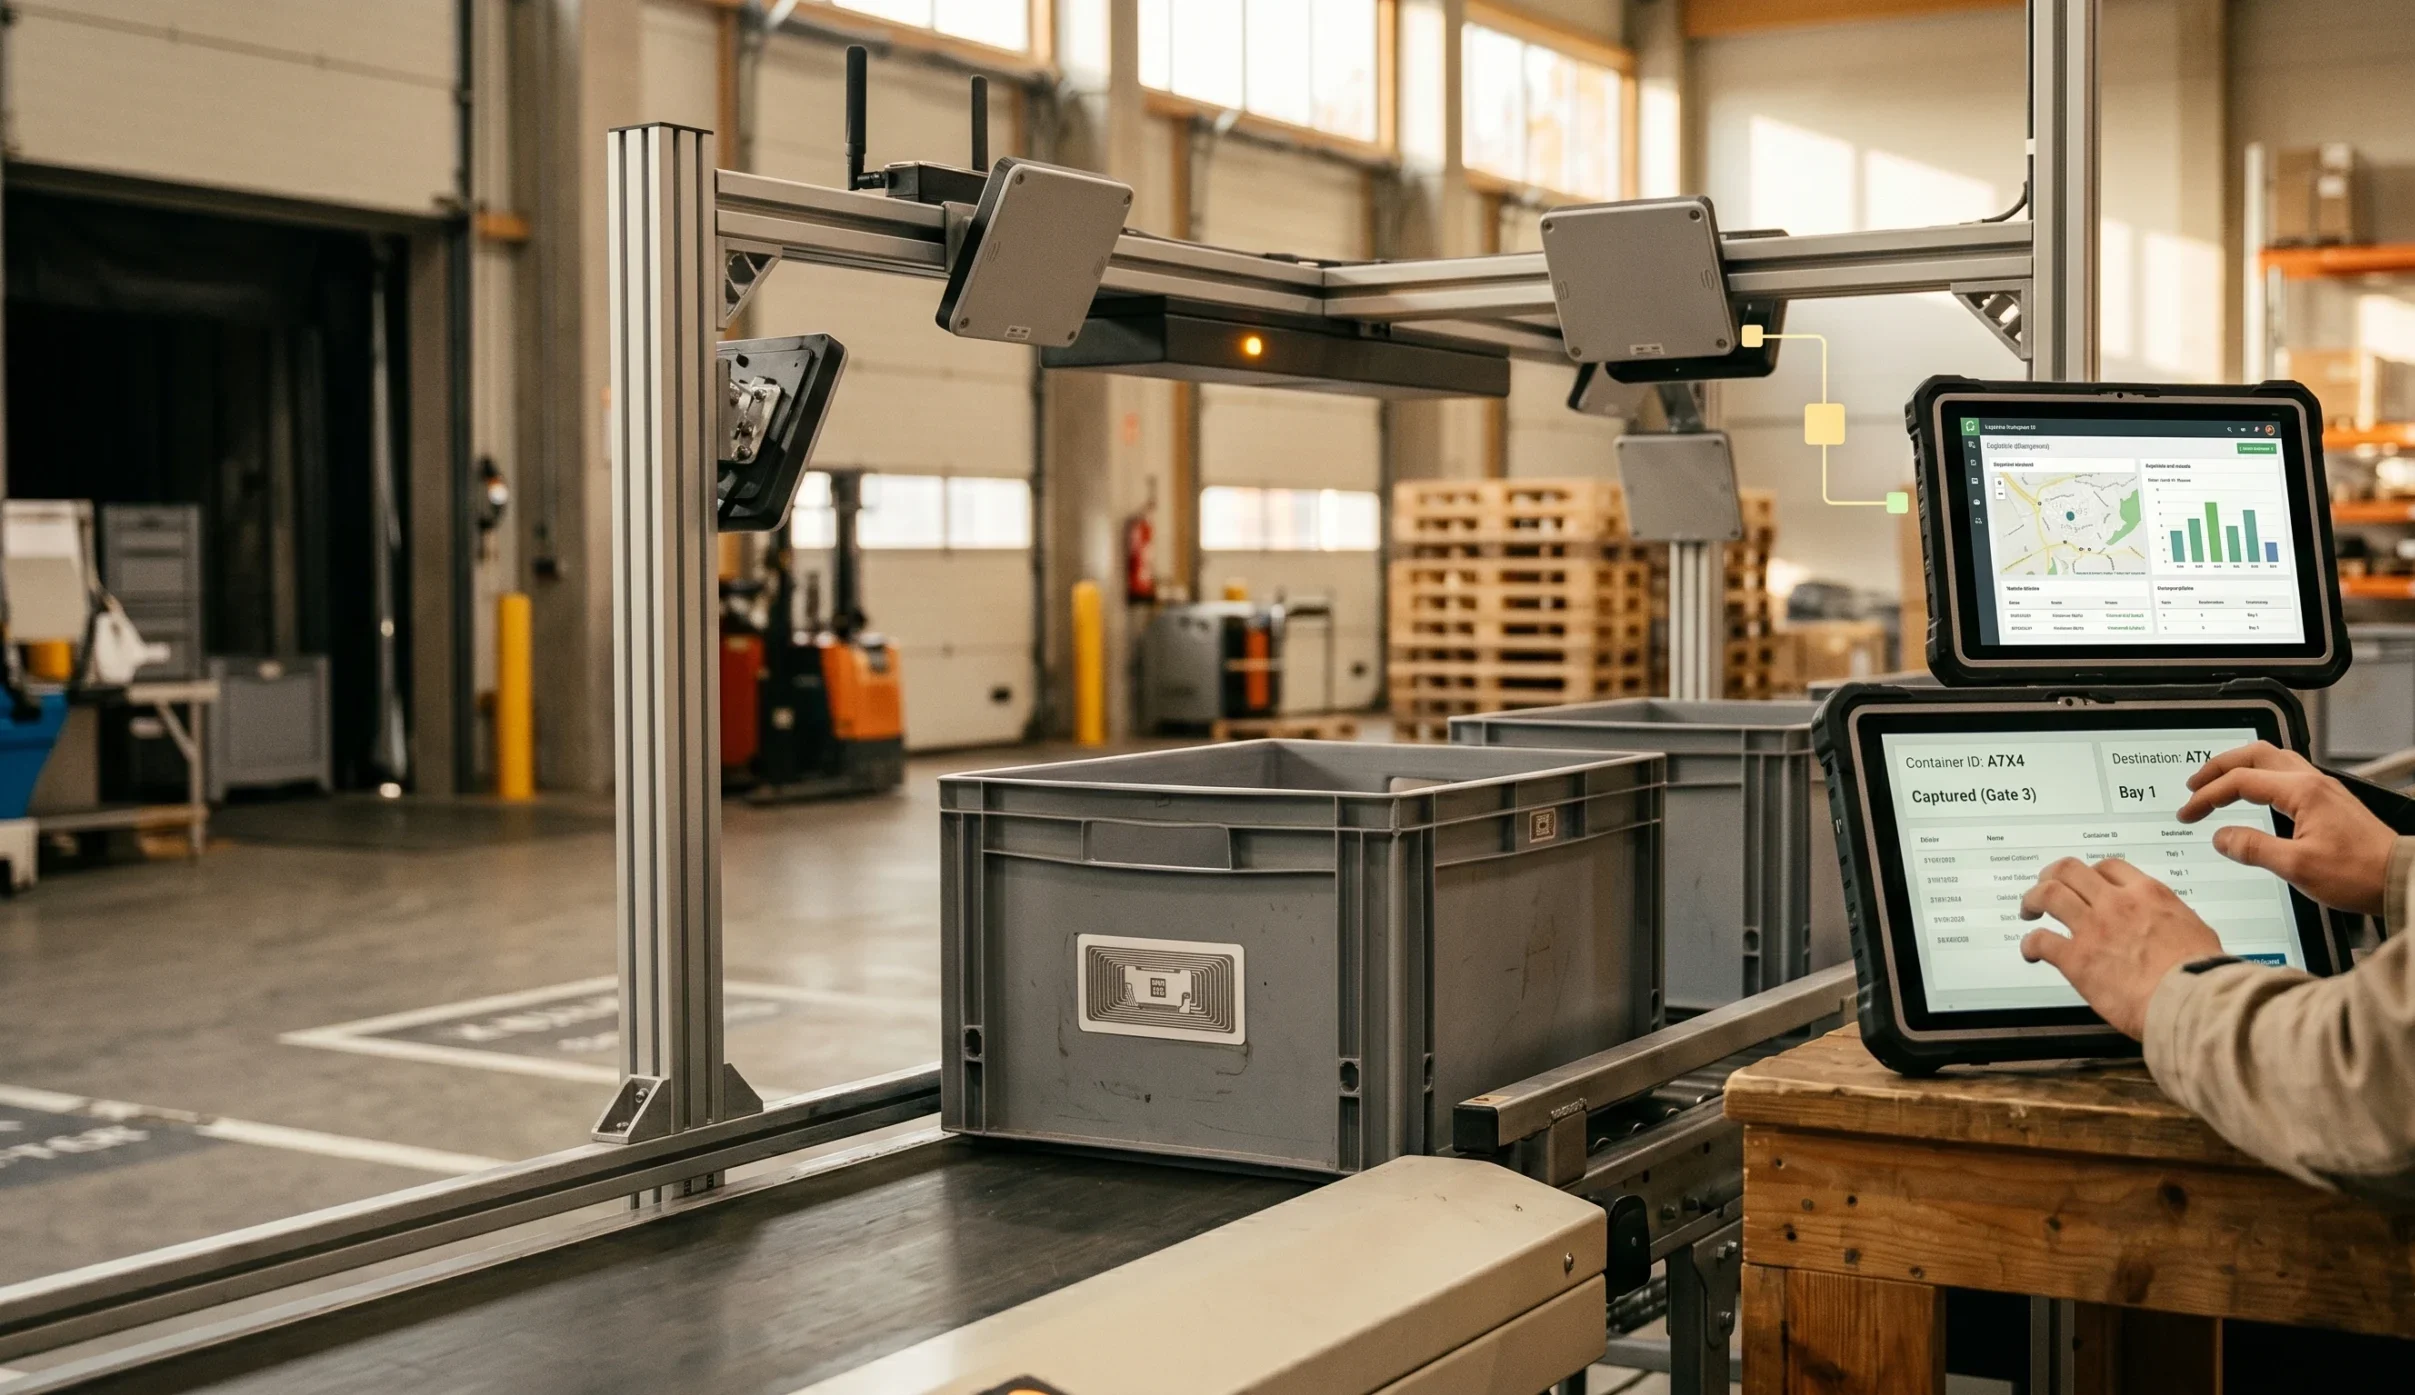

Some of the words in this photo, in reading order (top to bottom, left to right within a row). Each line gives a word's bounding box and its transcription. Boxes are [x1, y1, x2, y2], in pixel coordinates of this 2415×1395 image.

[1905, 756, 1964, 769] Container
[1967, 755, 1984, 768] ID:
[1987, 753, 2025, 768] A7X4
[2112, 752, 2182, 765] Destination:
[2185, 750, 2212, 764] ATX
[1911, 788, 1977, 806] Captured
[1980, 787, 2019, 805] (Gate
[2021, 786, 2037, 804] 3)
[2118, 785, 2144, 802] Bay
[2148, 785, 2156, 798] 1
[2082, 831, 2110, 839] Container
